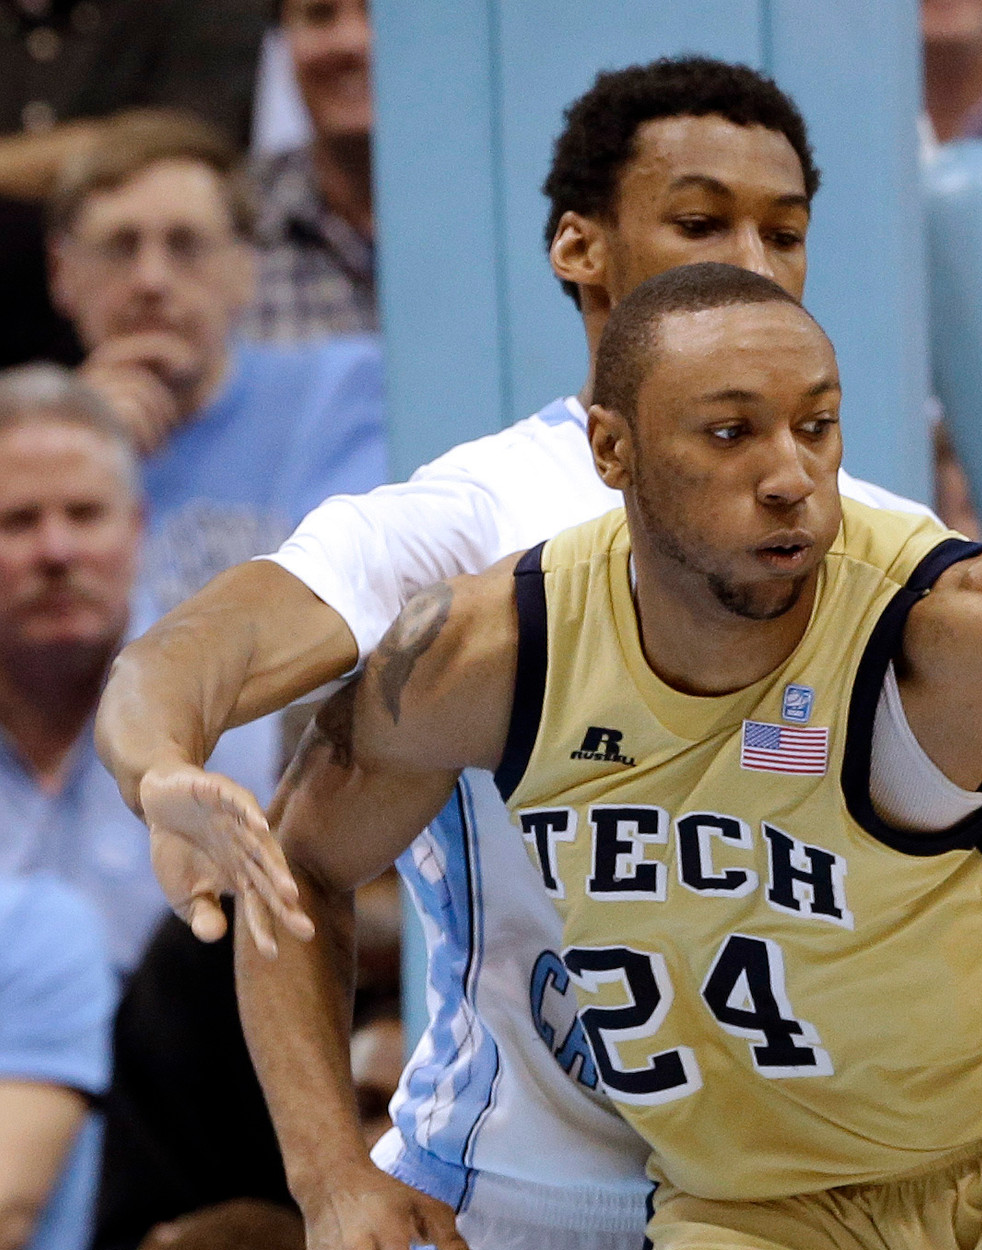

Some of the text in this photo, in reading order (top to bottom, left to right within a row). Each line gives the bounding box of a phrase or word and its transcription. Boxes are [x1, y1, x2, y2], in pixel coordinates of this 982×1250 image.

[570, 750, 637, 767] RUSSELL
[518, 803, 854, 930] TECH
[560, 933, 835, 1106] 24
